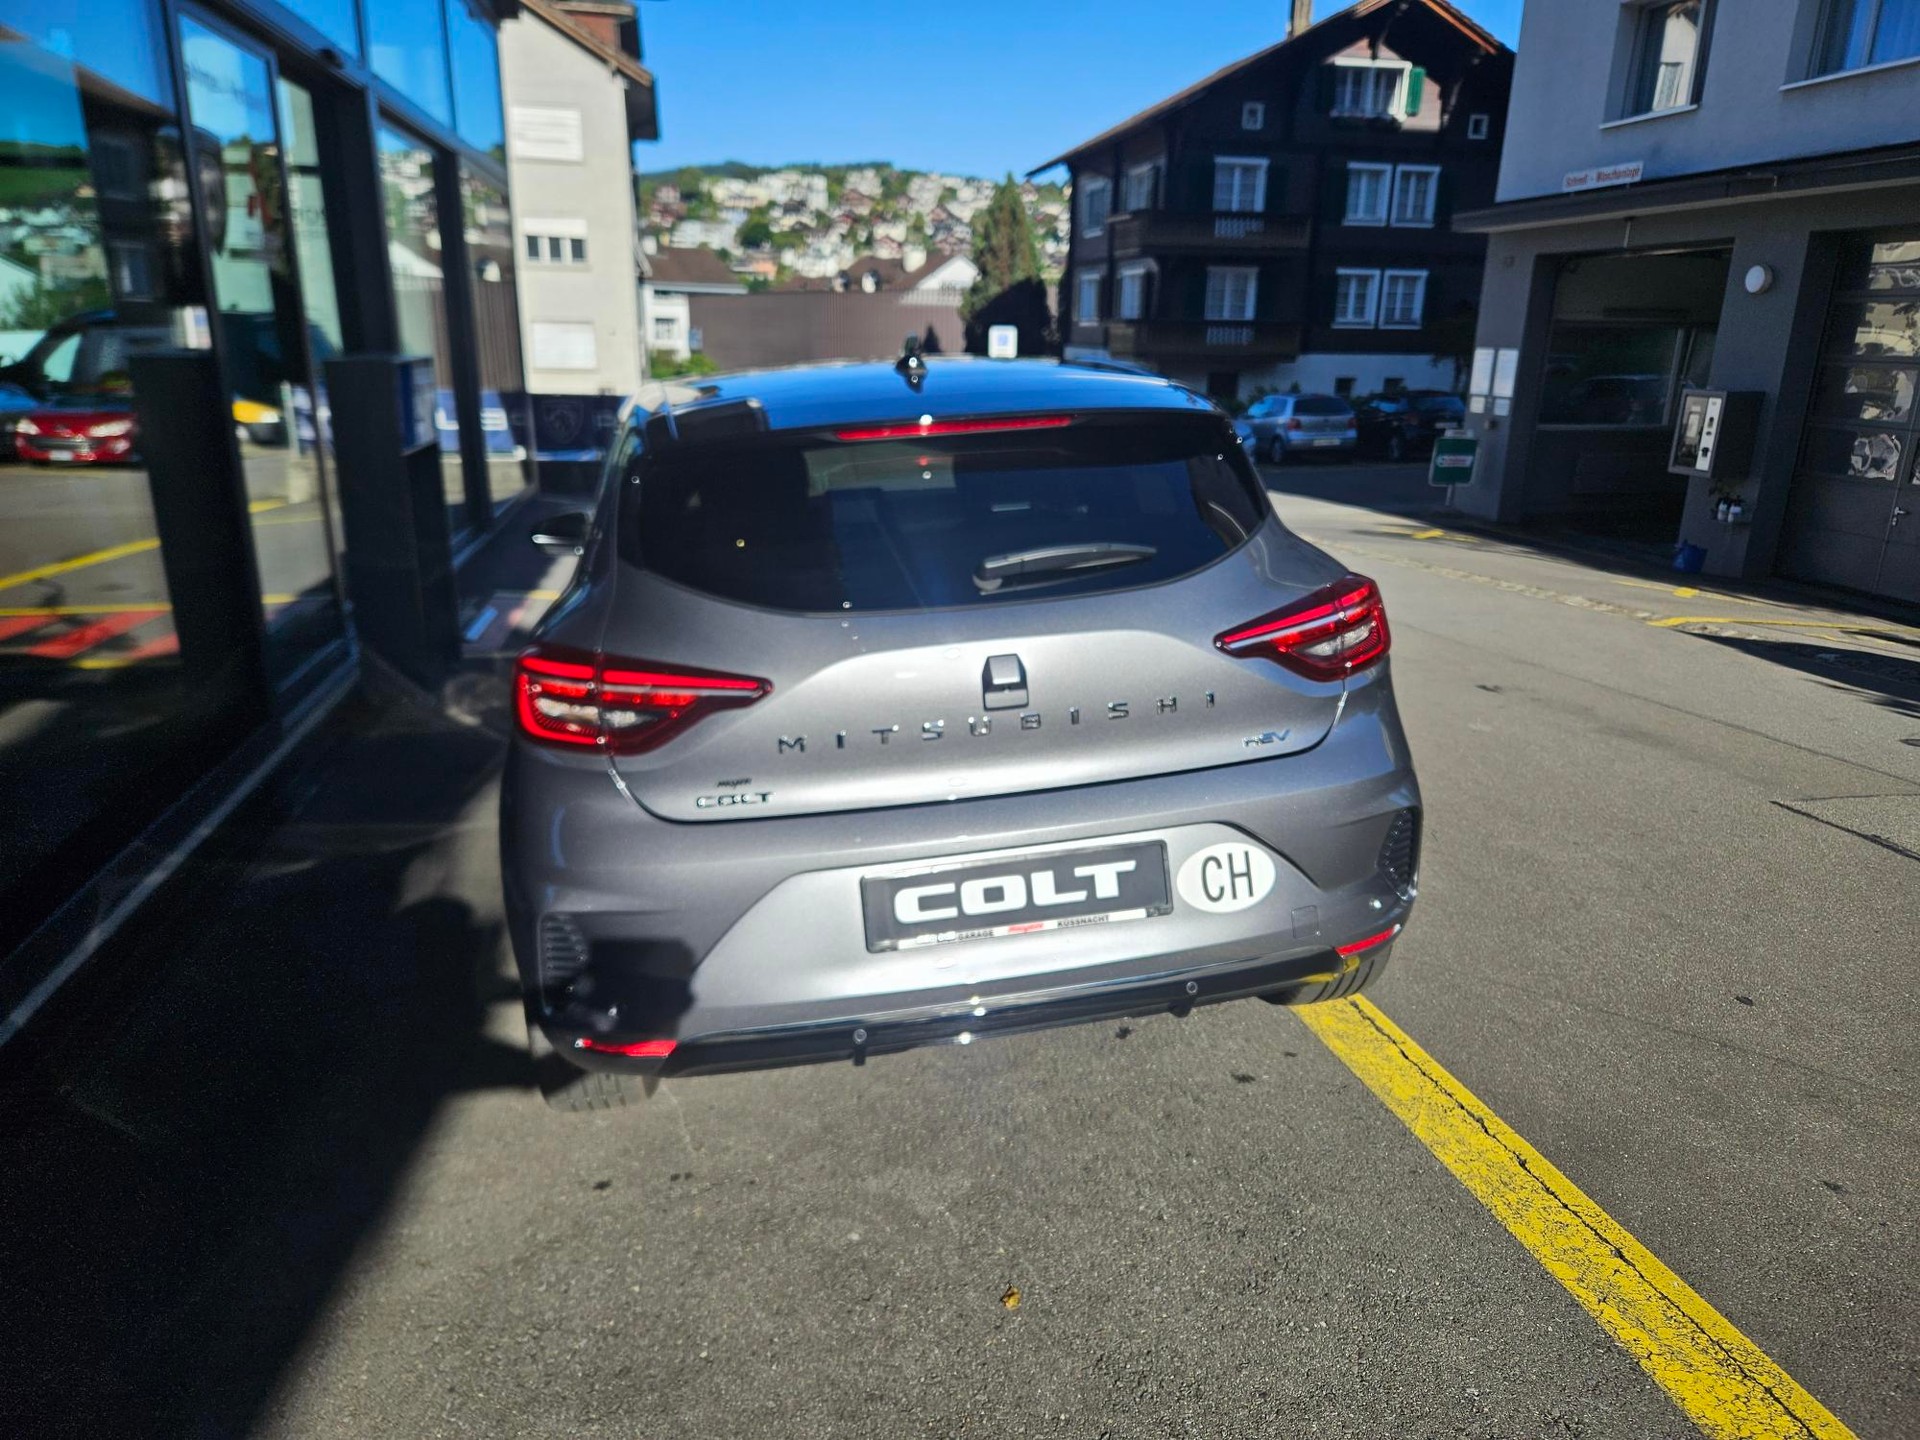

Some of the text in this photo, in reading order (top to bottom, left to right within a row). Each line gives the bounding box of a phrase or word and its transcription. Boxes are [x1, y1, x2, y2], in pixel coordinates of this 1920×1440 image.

[778, 690, 1215, 754] MITSUBISHI
[1242, 729, 1290, 748] HEV
[696, 791, 776, 808] COLT
[894, 860, 1137, 924] COLT
[1201, 850, 1254, 903] CH
[958, 928, 994, 941] GARAGE
